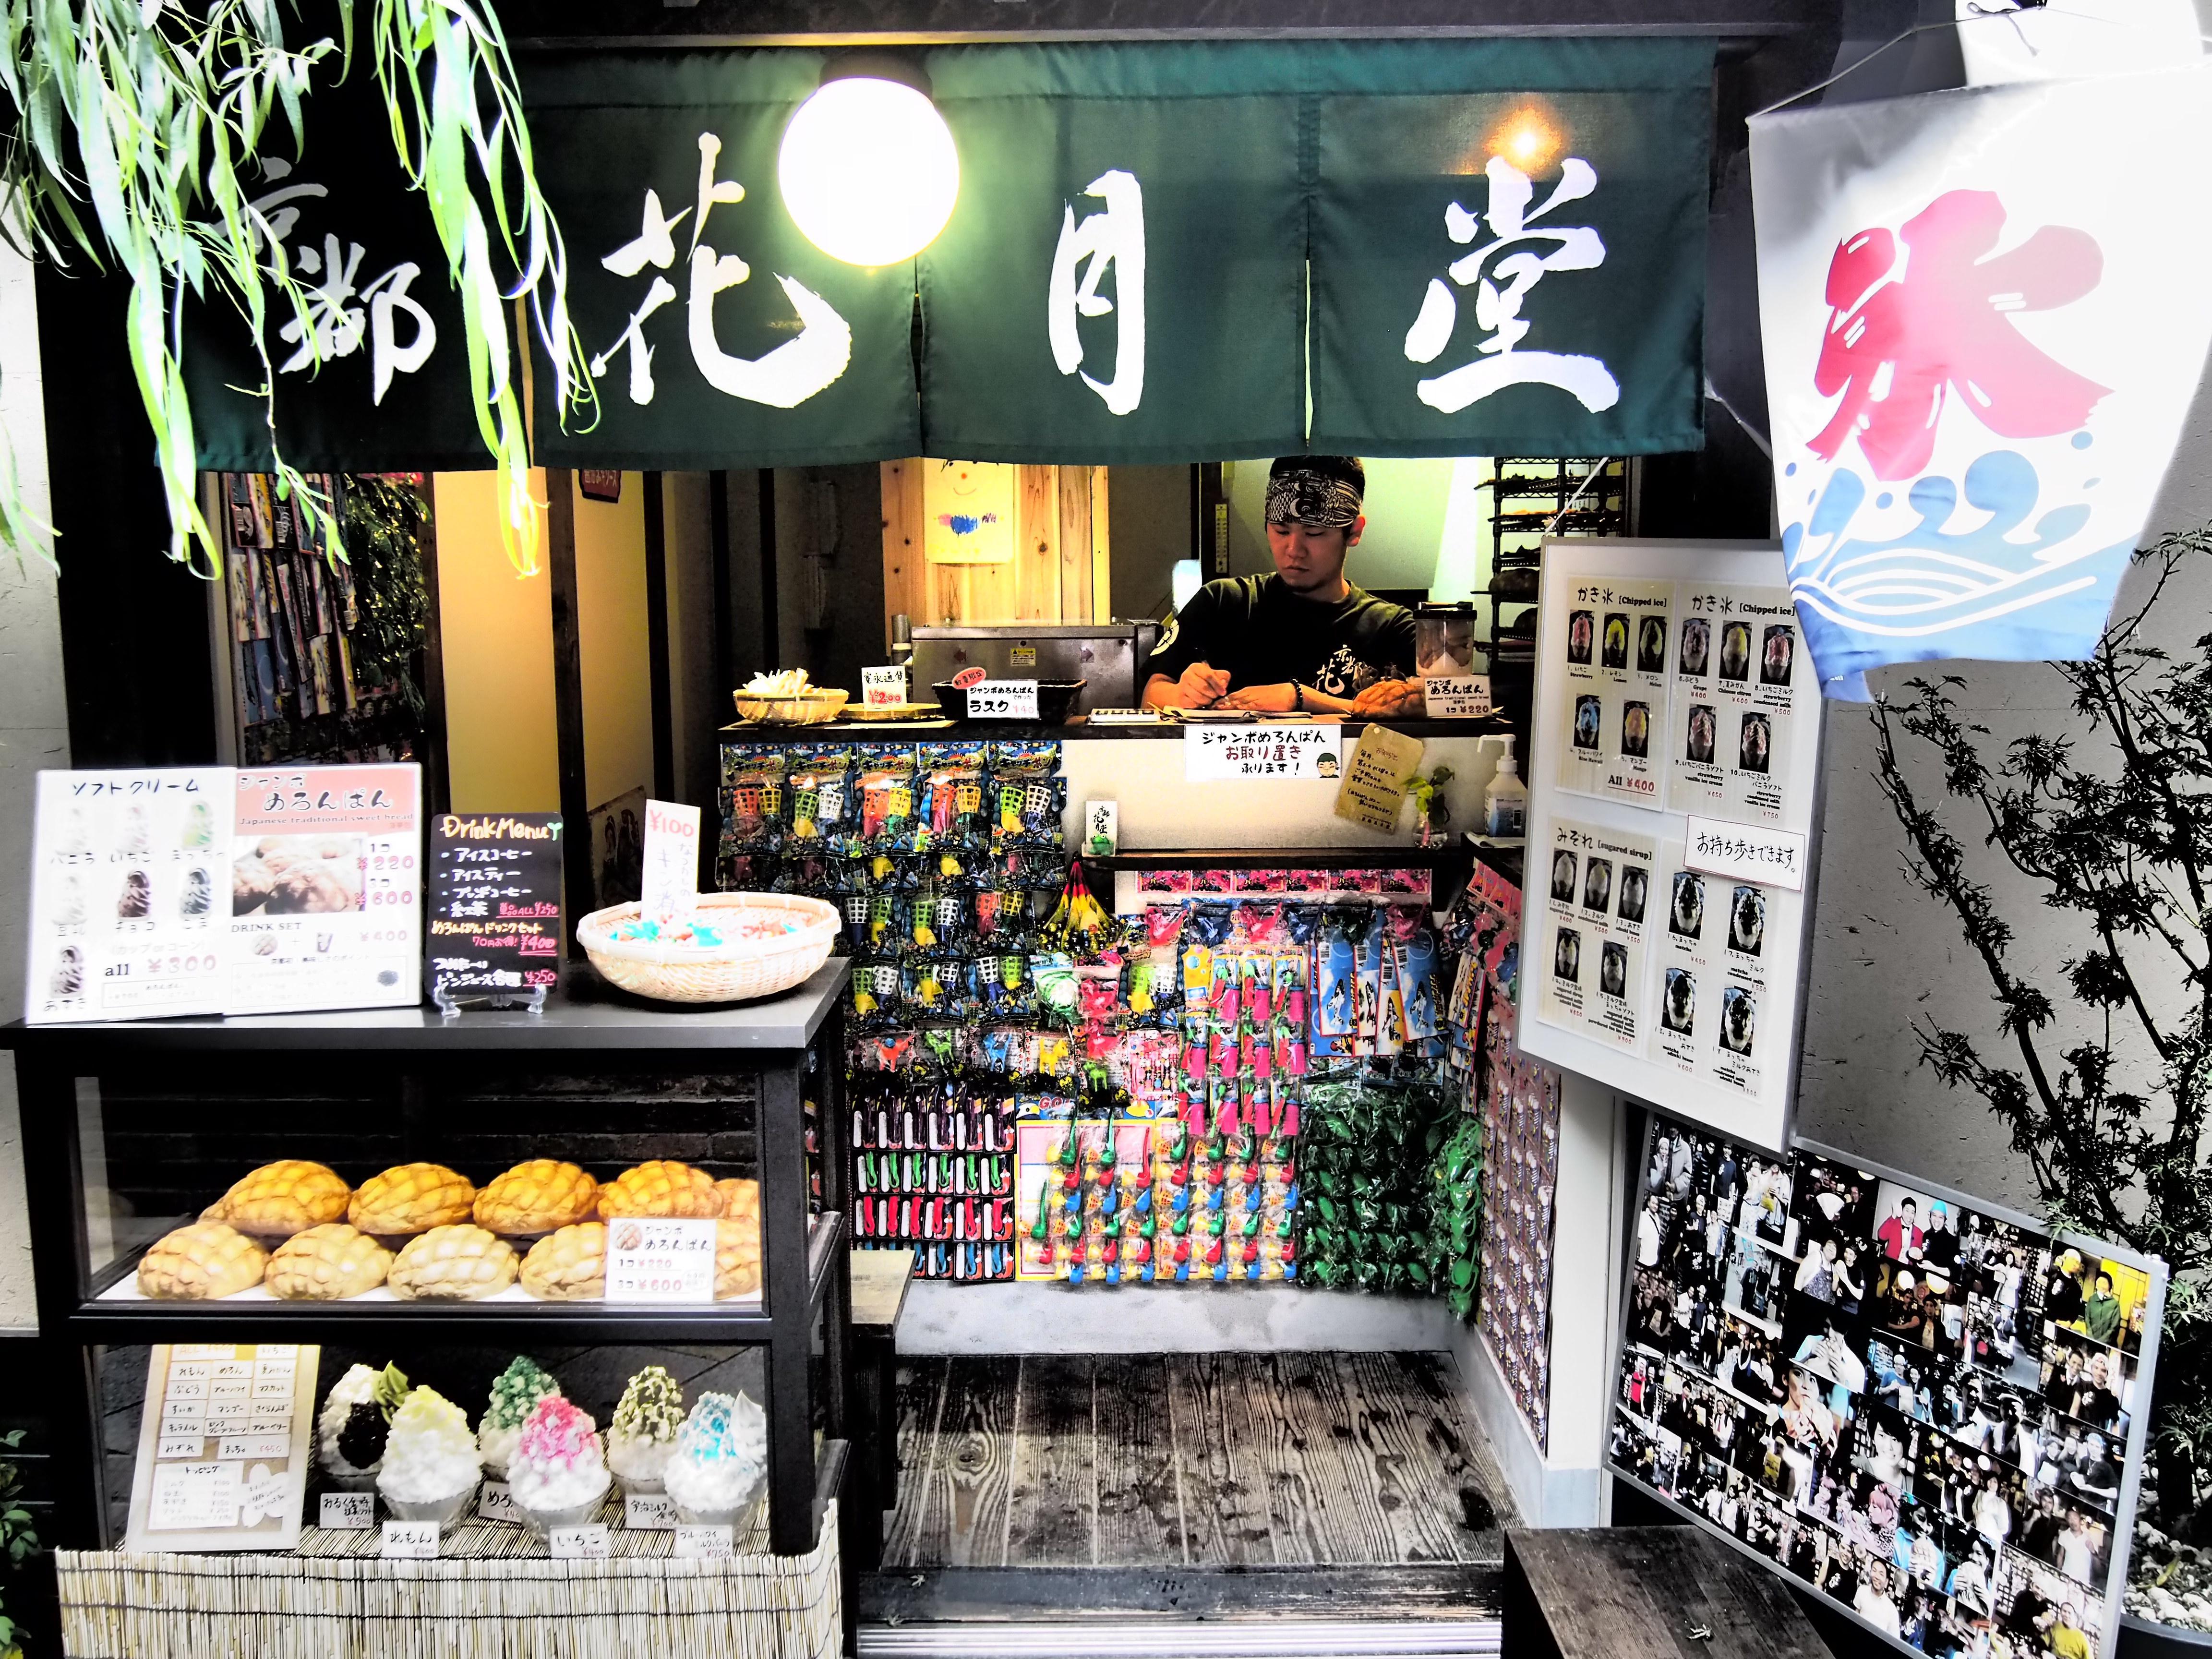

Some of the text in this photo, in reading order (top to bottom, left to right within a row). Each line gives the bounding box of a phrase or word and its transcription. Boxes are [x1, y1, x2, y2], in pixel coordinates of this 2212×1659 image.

[1806, 189, 2115, 481] 氷
[1578, 587, 1667, 607] かき氷 [Chipped ice]
[1692, 594, 1795, 616] かき氷 [Chipped ice]
[868, 689, 902, 705] ¥200
[970, 700, 1009, 712] ラスク
[1460, 705, 1489, 713] ¥220
[1202, 730, 1325, 744] ジャンボめろんぱん
[1226, 745, 1301, 761] お取り置き
[72, 779, 199, 796] ソフトクリーム
[1608, 774, 1655, 792] All ¥400
[263, 789, 392, 811] めろんぱん
[649, 809, 694, 837] ¥100
[1557, 827, 1652, 860] みぞれ [sugared sirup]
[357, 855, 415, 871] ¥220
[452, 866, 521, 882] アイスティー
[355, 890, 413, 905] ¥600
[231, 922, 302, 933] DRINK SET
[105, 954, 216, 976] all ¥300
[638, 1258, 672, 1268] ¥220
[638, 1278, 683, 1291] ¥600
[487, 1491, 513, 1508] めろ
[390, 1530, 432, 1544] れもん
